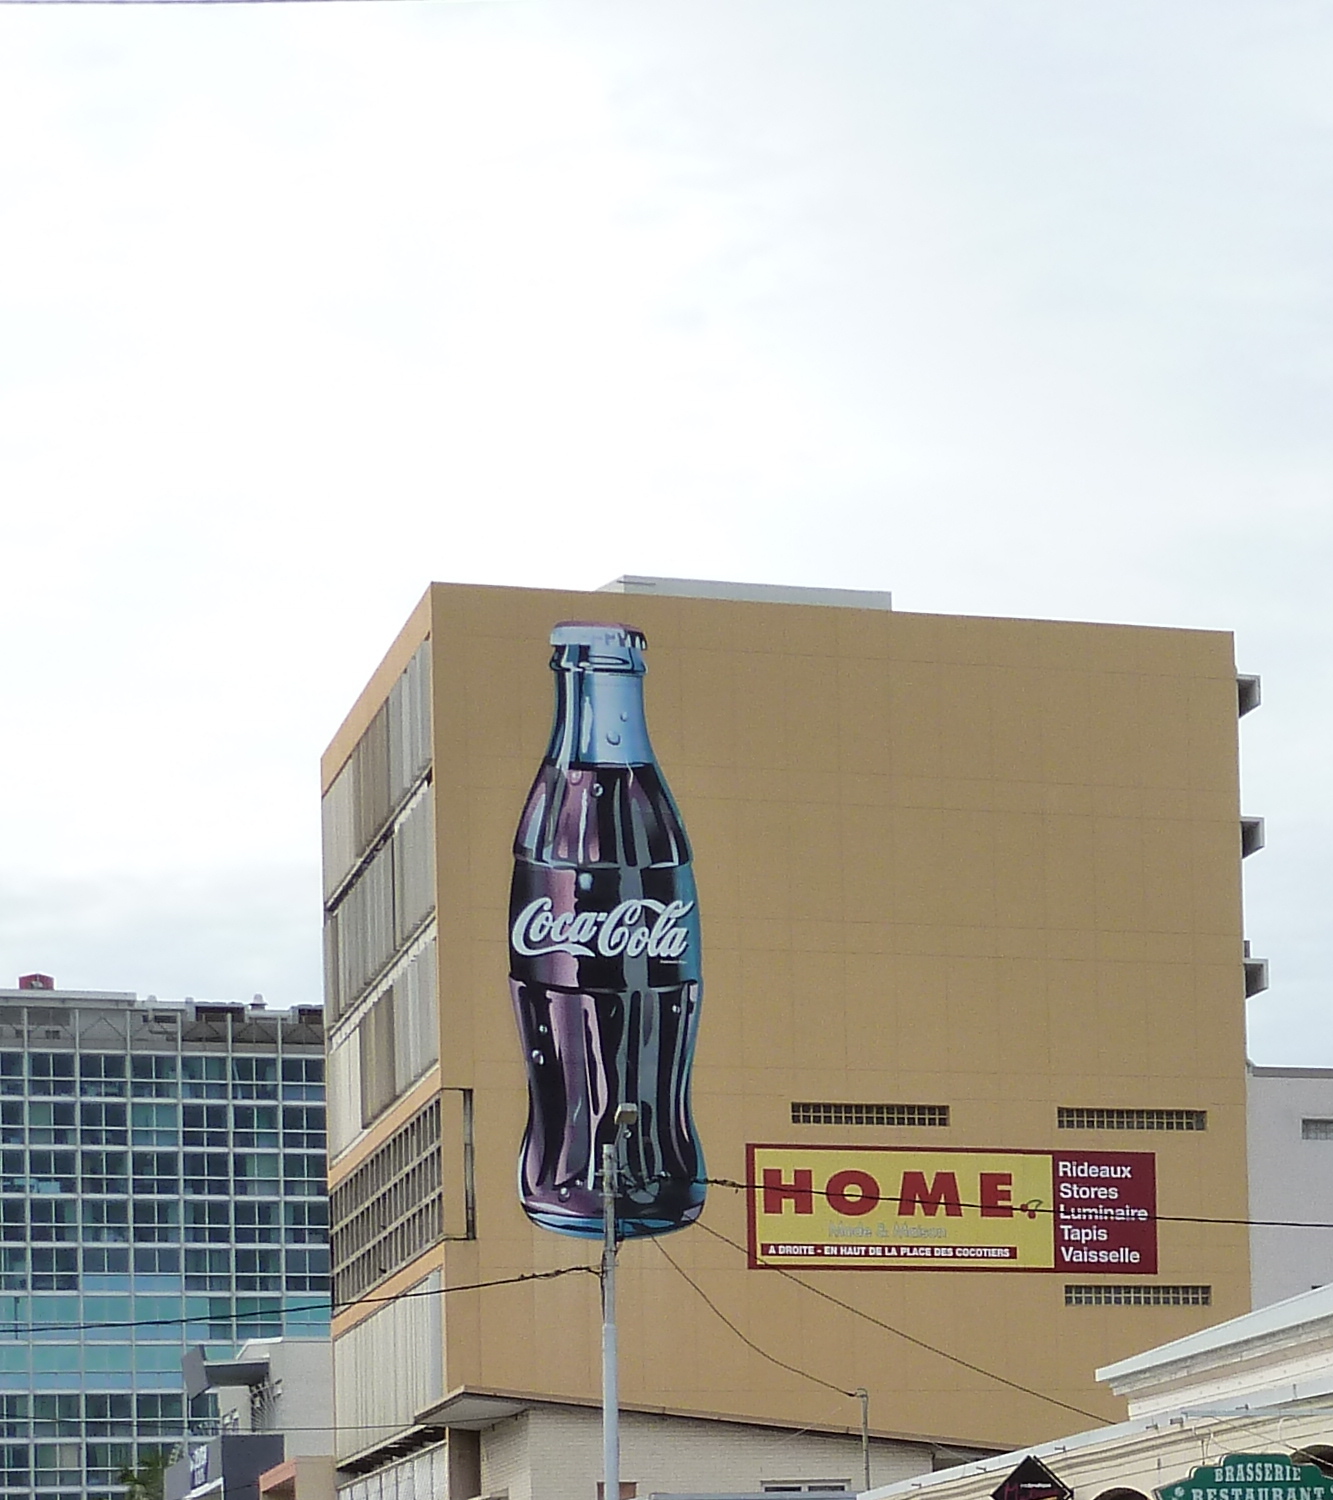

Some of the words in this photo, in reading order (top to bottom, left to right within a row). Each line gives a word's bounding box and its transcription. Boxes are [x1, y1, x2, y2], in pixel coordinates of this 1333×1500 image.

[512, 897, 694, 958] Coca-Cola
[1058, 1161, 1132, 1179] Rideaux
[762, 1167, 1014, 1219] HOME
[1059, 1183, 1119, 1200] Stores
[1059, 1205, 1148, 1221] Luminaire
[1060, 1225, 1108, 1243] Tapis
[768, 1246, 776, 1255] A
[777, 1246, 815, 1256] DROITE
[823, 1246, 838, 1256] EN
[840, 1246, 867, 1256] HAUT
[869, 1247, 883, 1257] DE
[885, 1247, 898, 1257] LA
[900, 1247, 928, 1258] PLACE
[930, 1248, 954, 1258] DES
[955, 1247, 1011, 1258] COCOTIERS
[1060, 1246, 1141, 1263] Vaisselle
[1214, 1462, 1302, 1483] BRASSERIE
